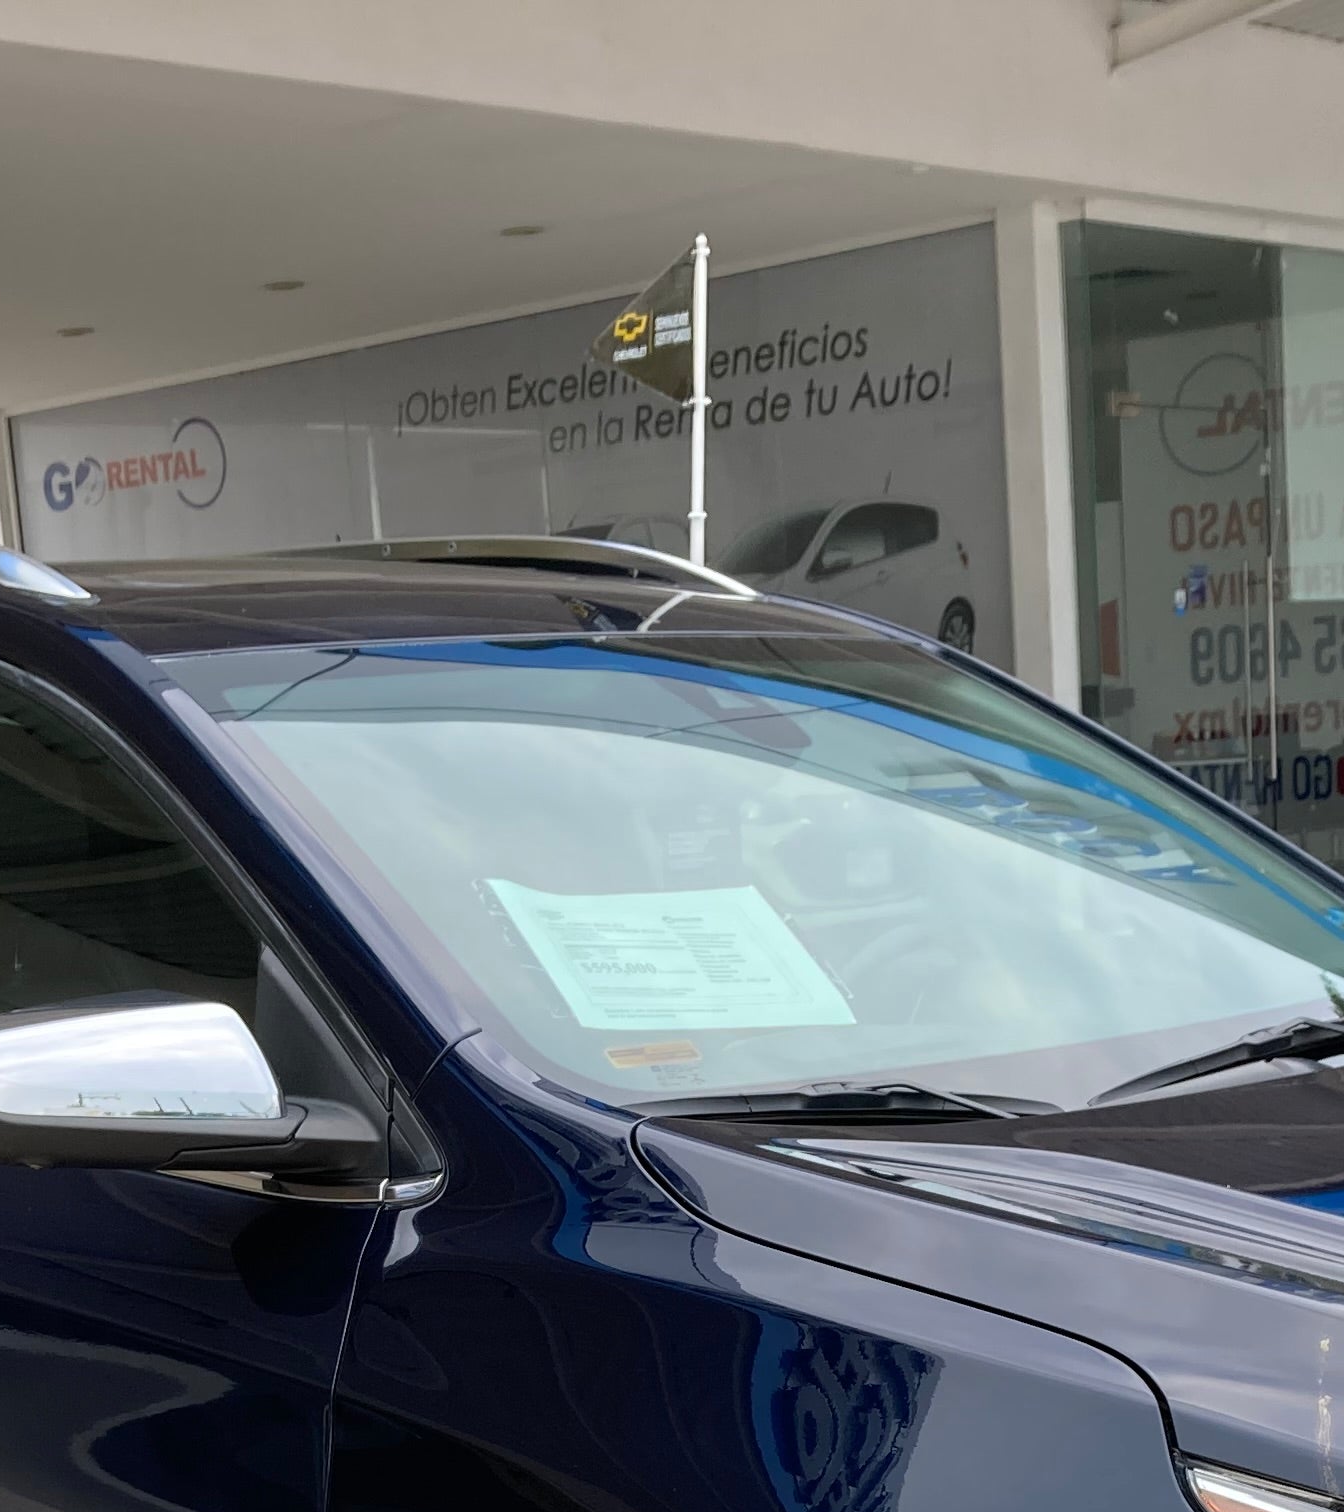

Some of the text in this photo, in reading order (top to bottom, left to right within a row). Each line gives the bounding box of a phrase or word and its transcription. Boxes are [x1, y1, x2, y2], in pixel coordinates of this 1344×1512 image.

[708, 322, 869, 380] eneficios
[549, 423, 587, 452] en
[597, 409, 624, 446] la
[745, 385, 792, 426] de
[805, 377, 838, 419] tu
[850, 358, 952, 412] Auto!
[106, 448, 207, 491] RENTAL
